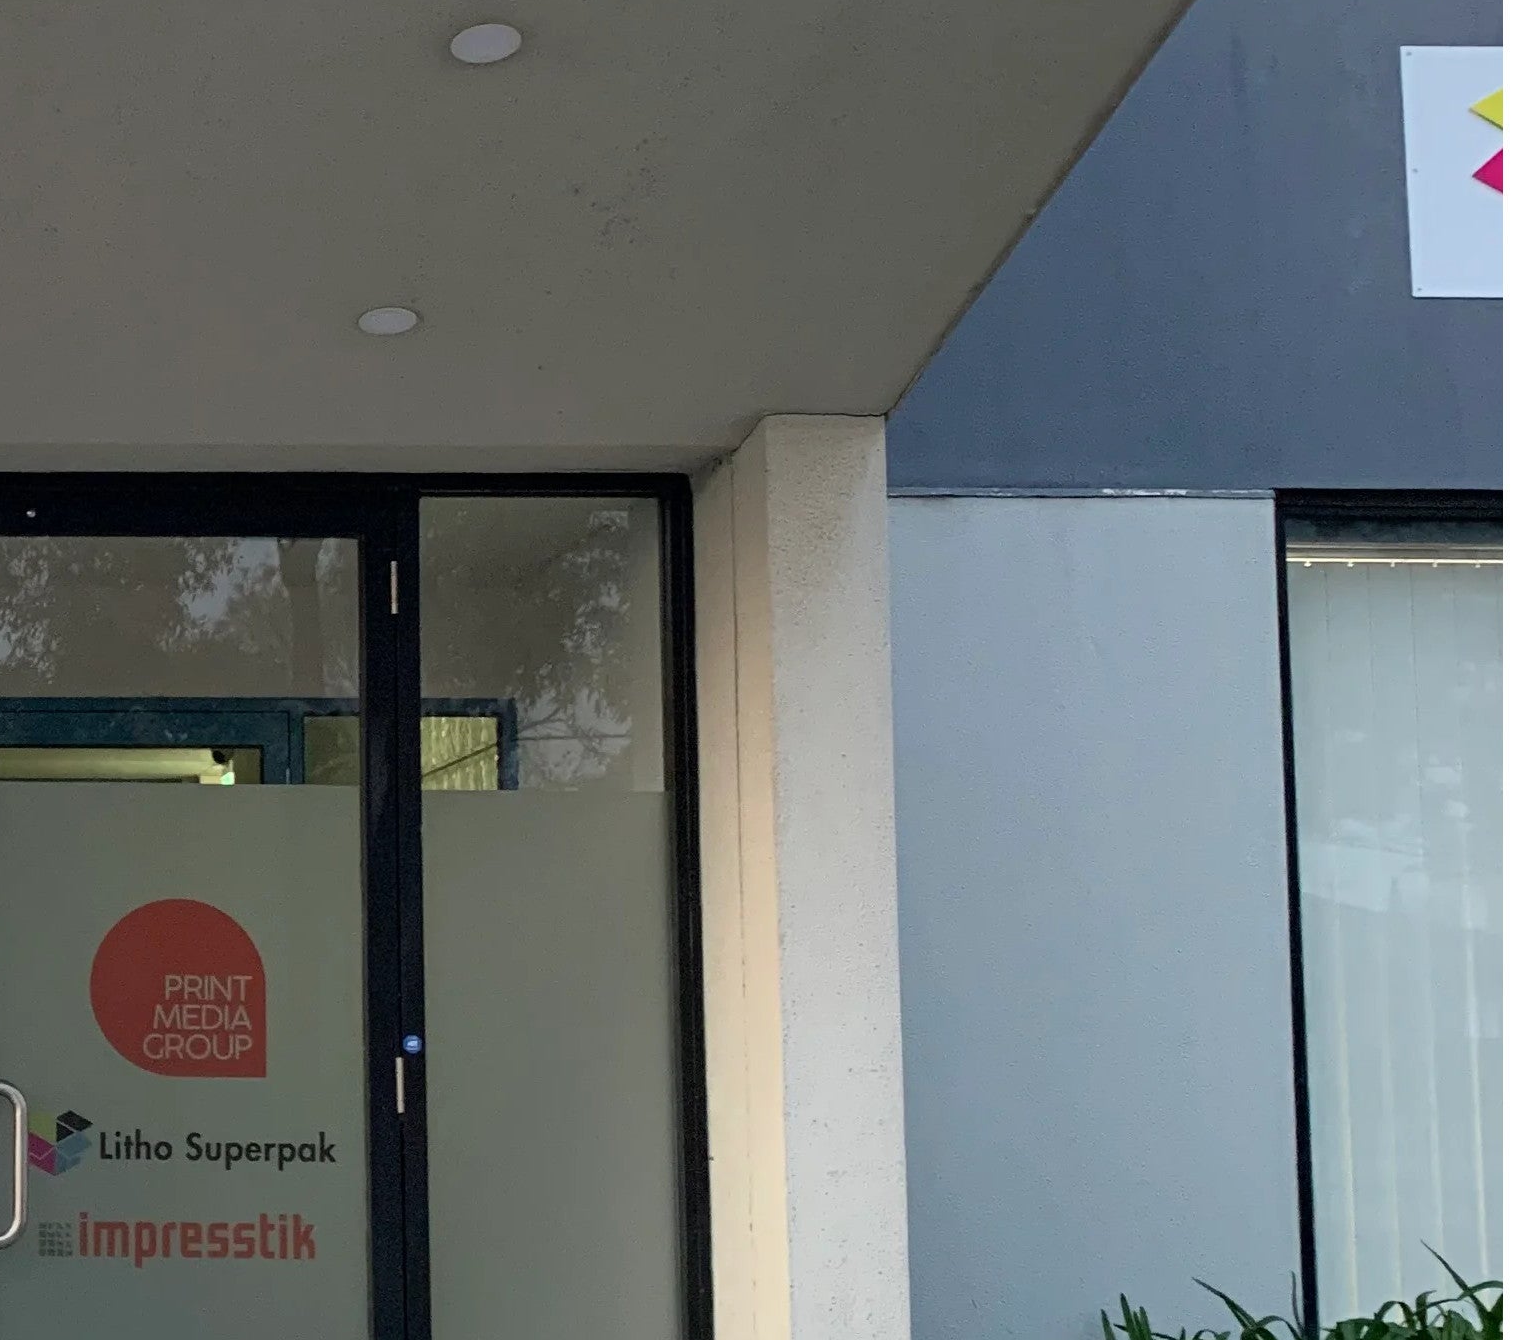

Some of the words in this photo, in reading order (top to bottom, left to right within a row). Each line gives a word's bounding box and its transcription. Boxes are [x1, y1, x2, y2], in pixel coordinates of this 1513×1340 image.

[164, 975, 253, 1001] PRINT
[153, 1003, 253, 1030] MEDIA
[143, 1033, 253, 1060] GROUP
[99, 1129, 173, 1161] Litho
[185, 1131, 336, 1171] Superpak
[79, 1212, 316, 1269] impresstik
